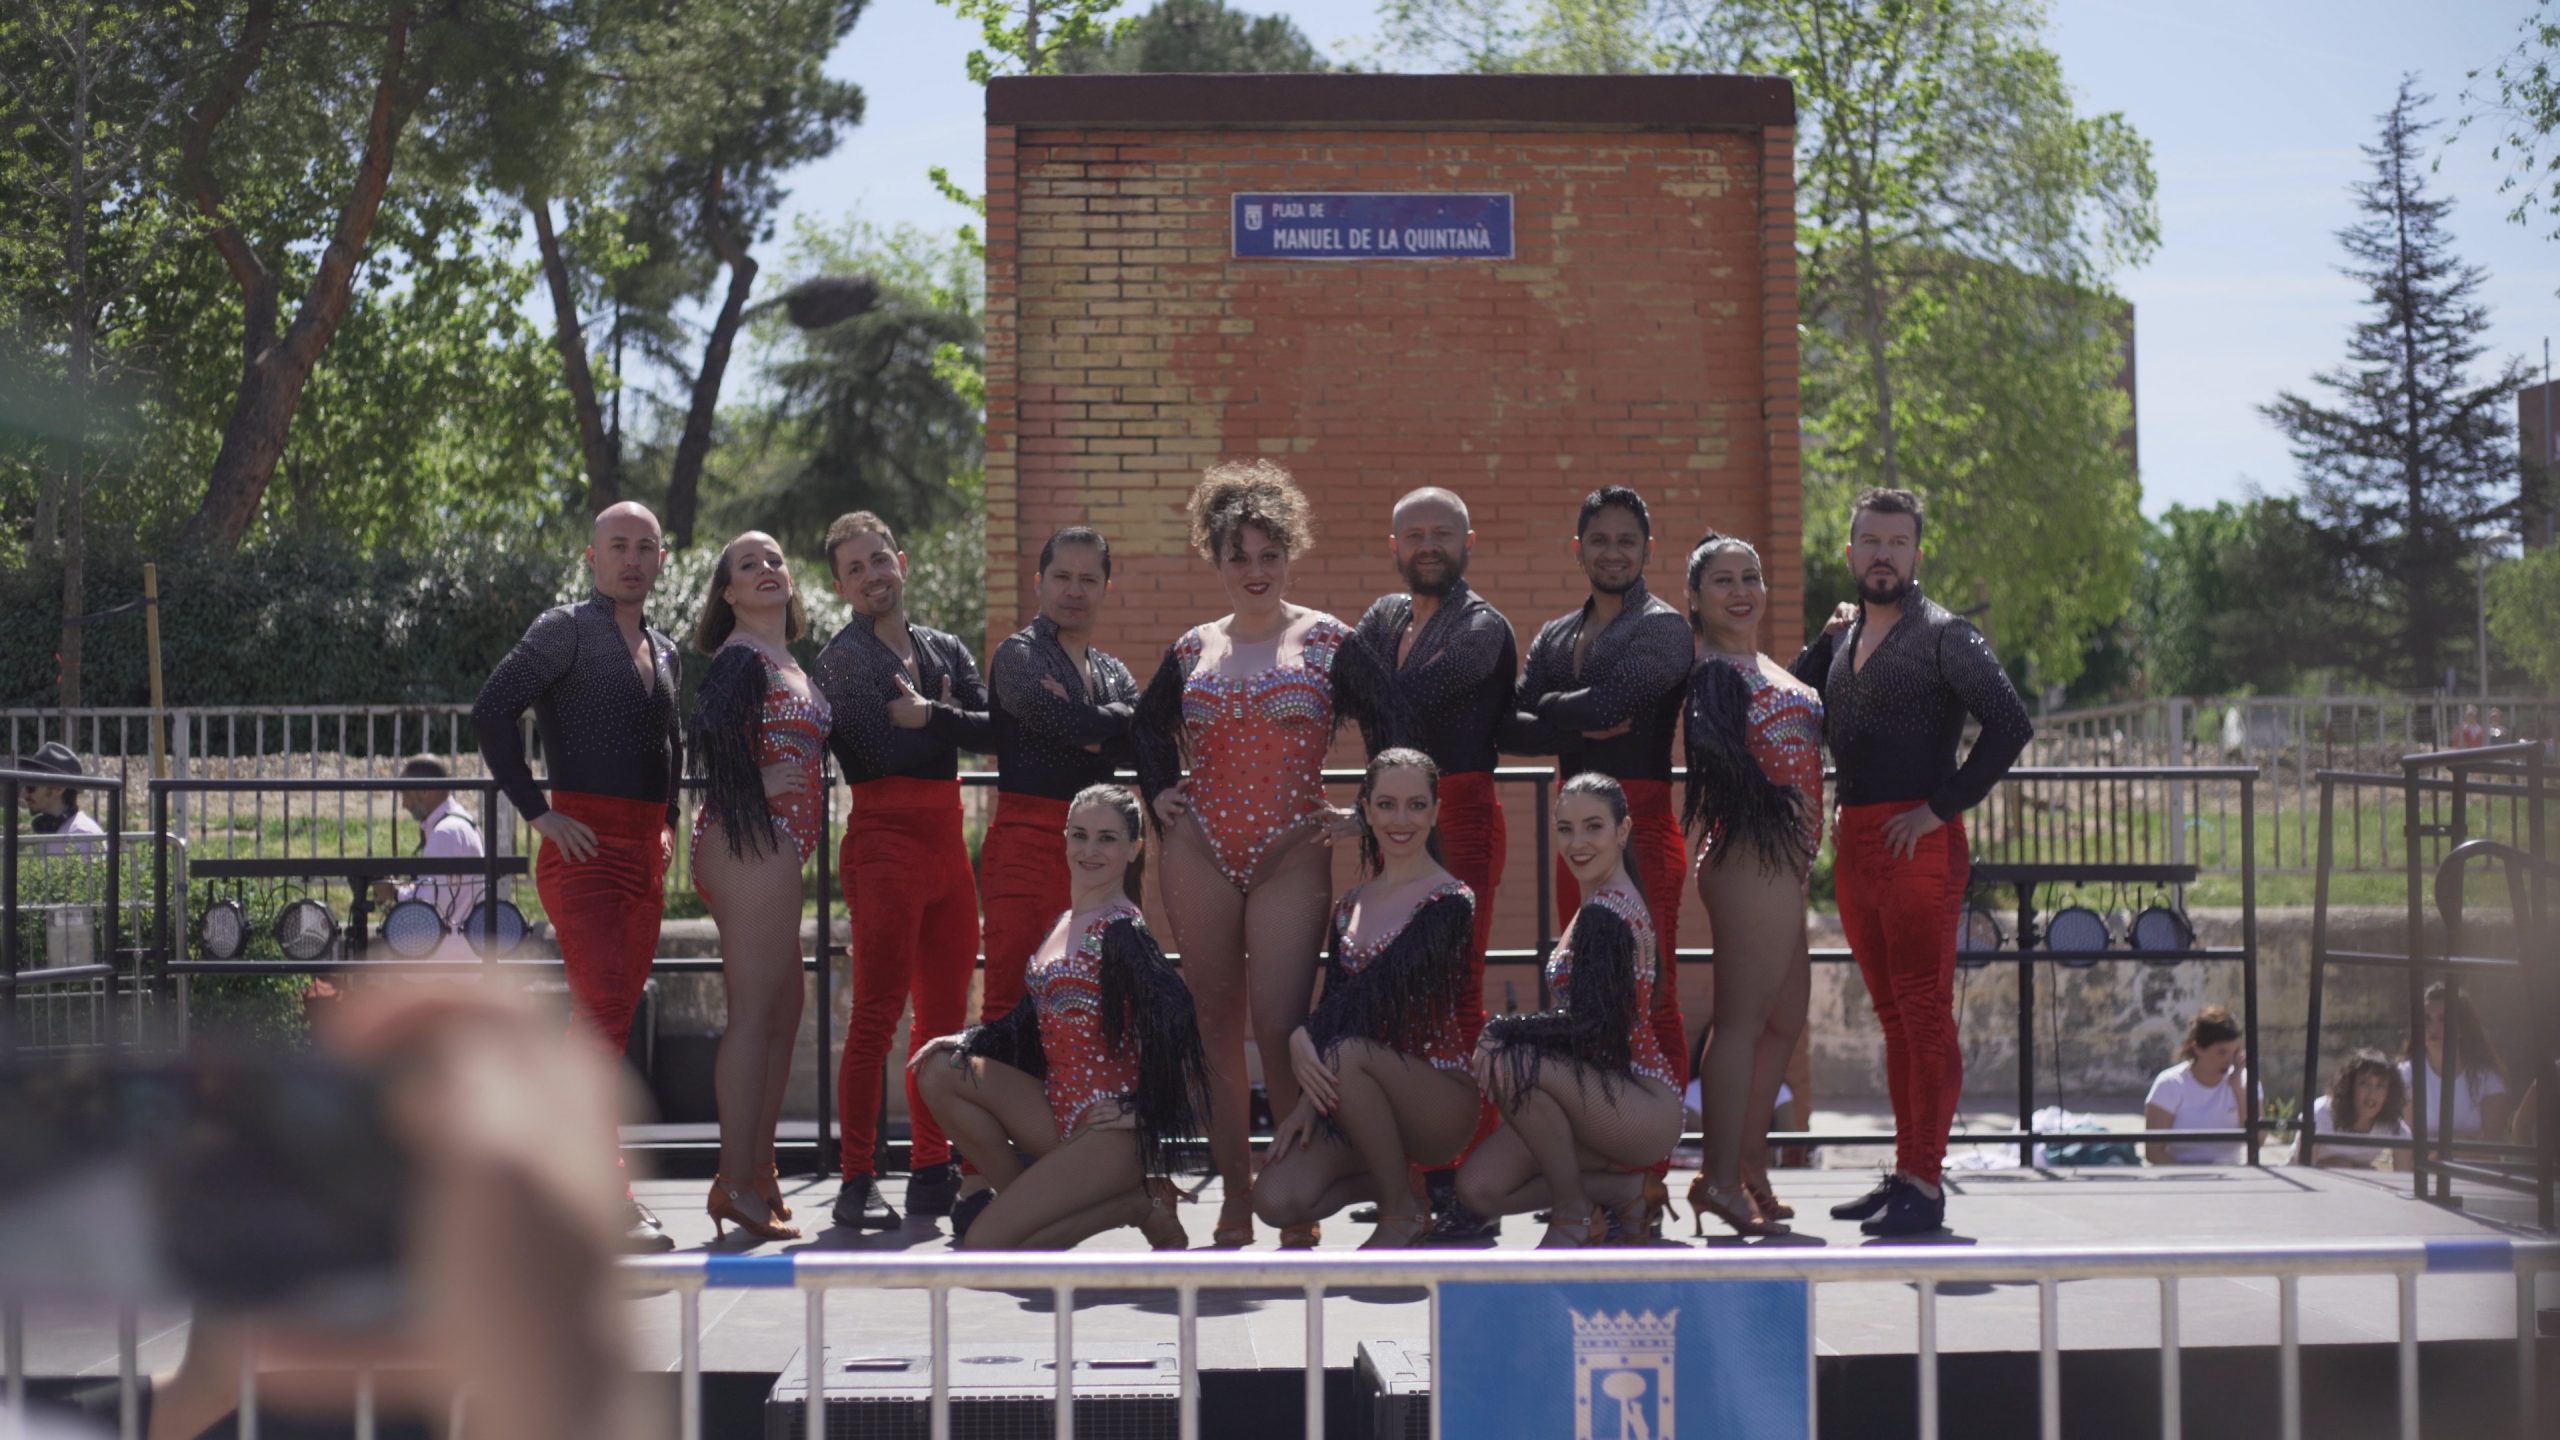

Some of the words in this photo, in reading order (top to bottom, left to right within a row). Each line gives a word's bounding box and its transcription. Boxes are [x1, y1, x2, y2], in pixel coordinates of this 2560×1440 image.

[1272, 203, 1304, 218] PLAZA
[1309, 203, 1325, 218] DE
[1273, 228, 1342, 250] MANUEL
[1349, 228, 1372, 249] DE
[1378, 228, 1399, 250] LA
